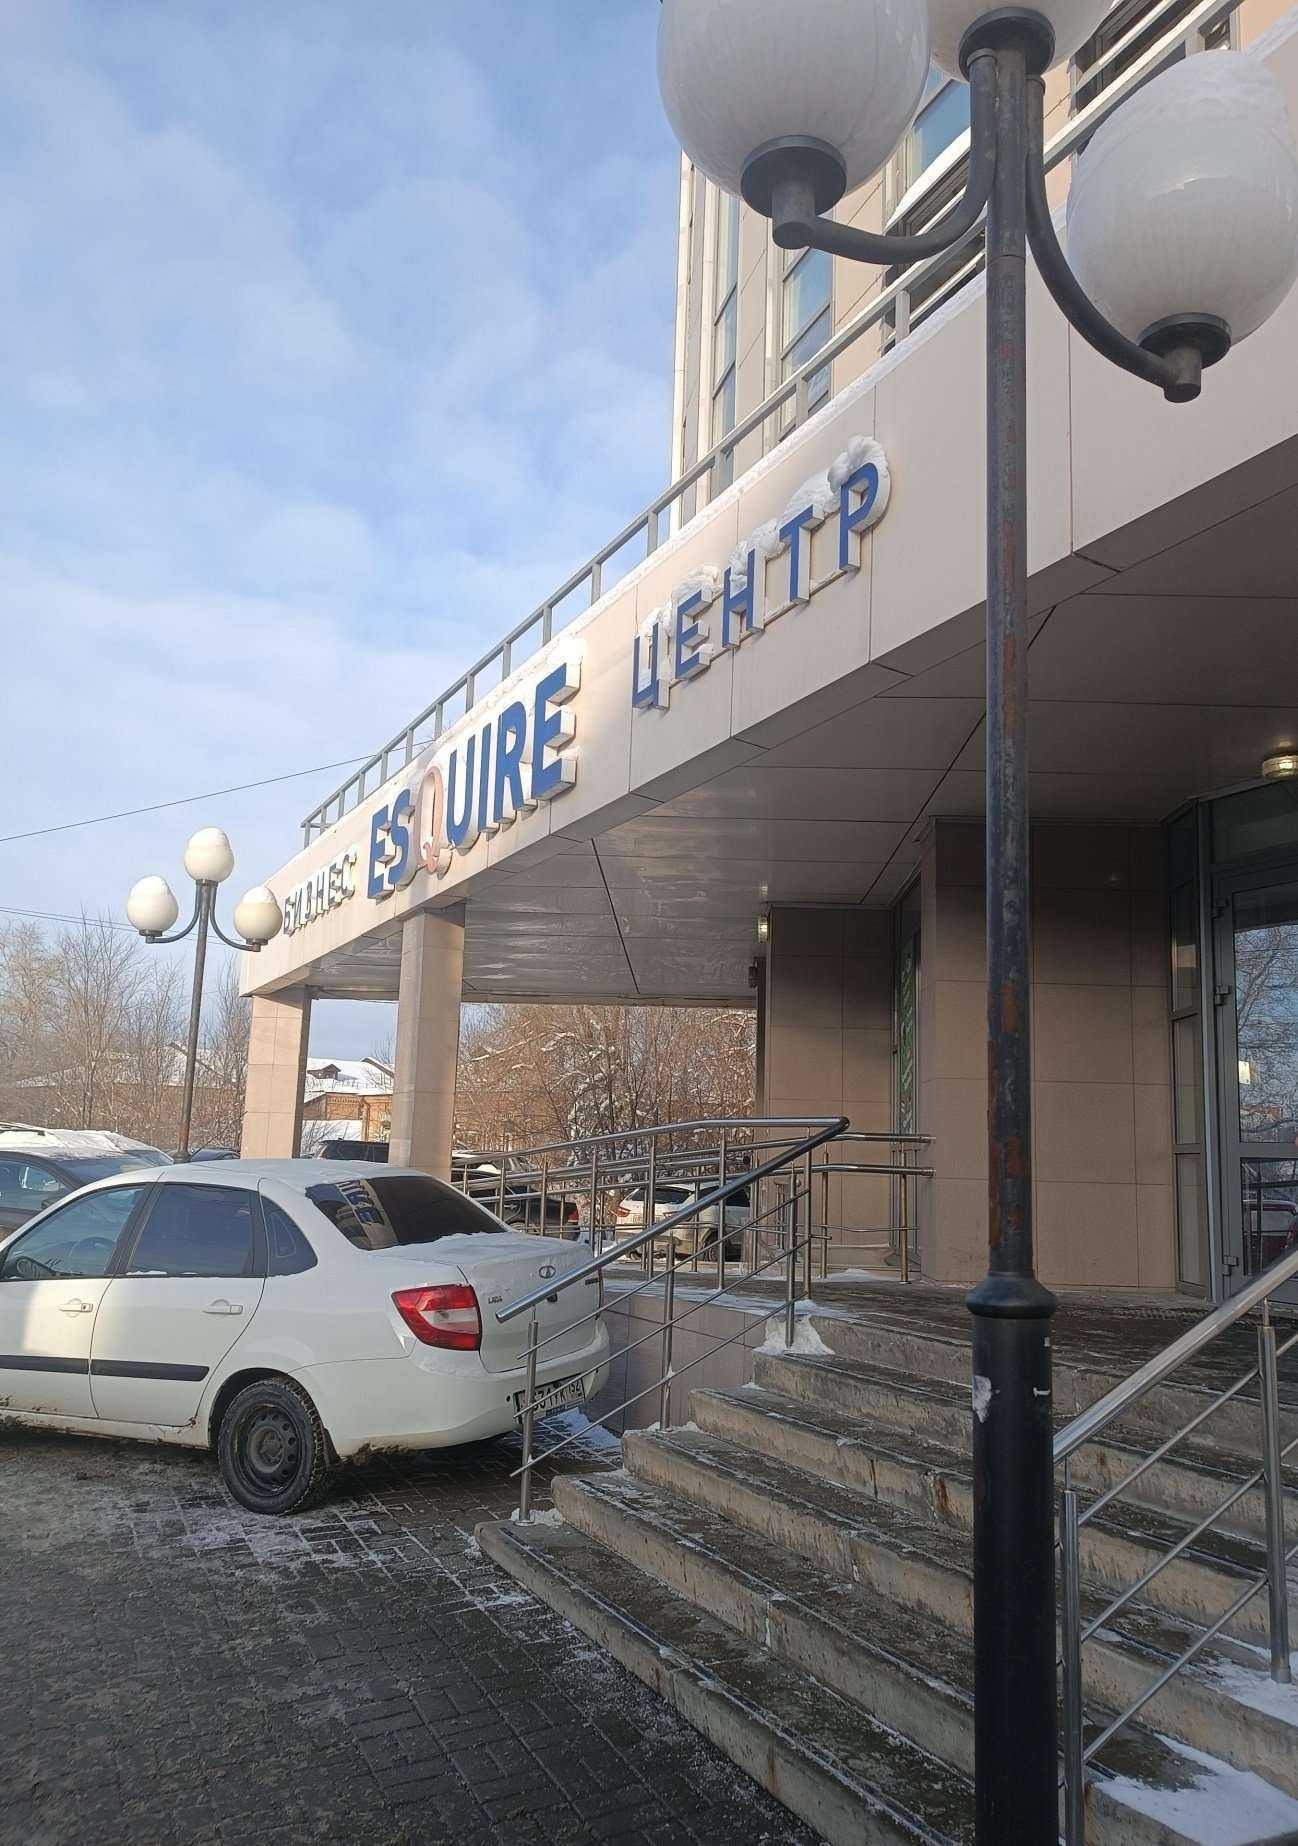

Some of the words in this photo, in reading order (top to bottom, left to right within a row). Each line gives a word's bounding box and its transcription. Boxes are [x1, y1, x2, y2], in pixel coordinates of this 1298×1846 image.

[283, 852, 355, 934] БИЗНЕС
[367, 661, 570, 899] ESQUIRE
[632, 461, 879, 709] ЦЕНТР
